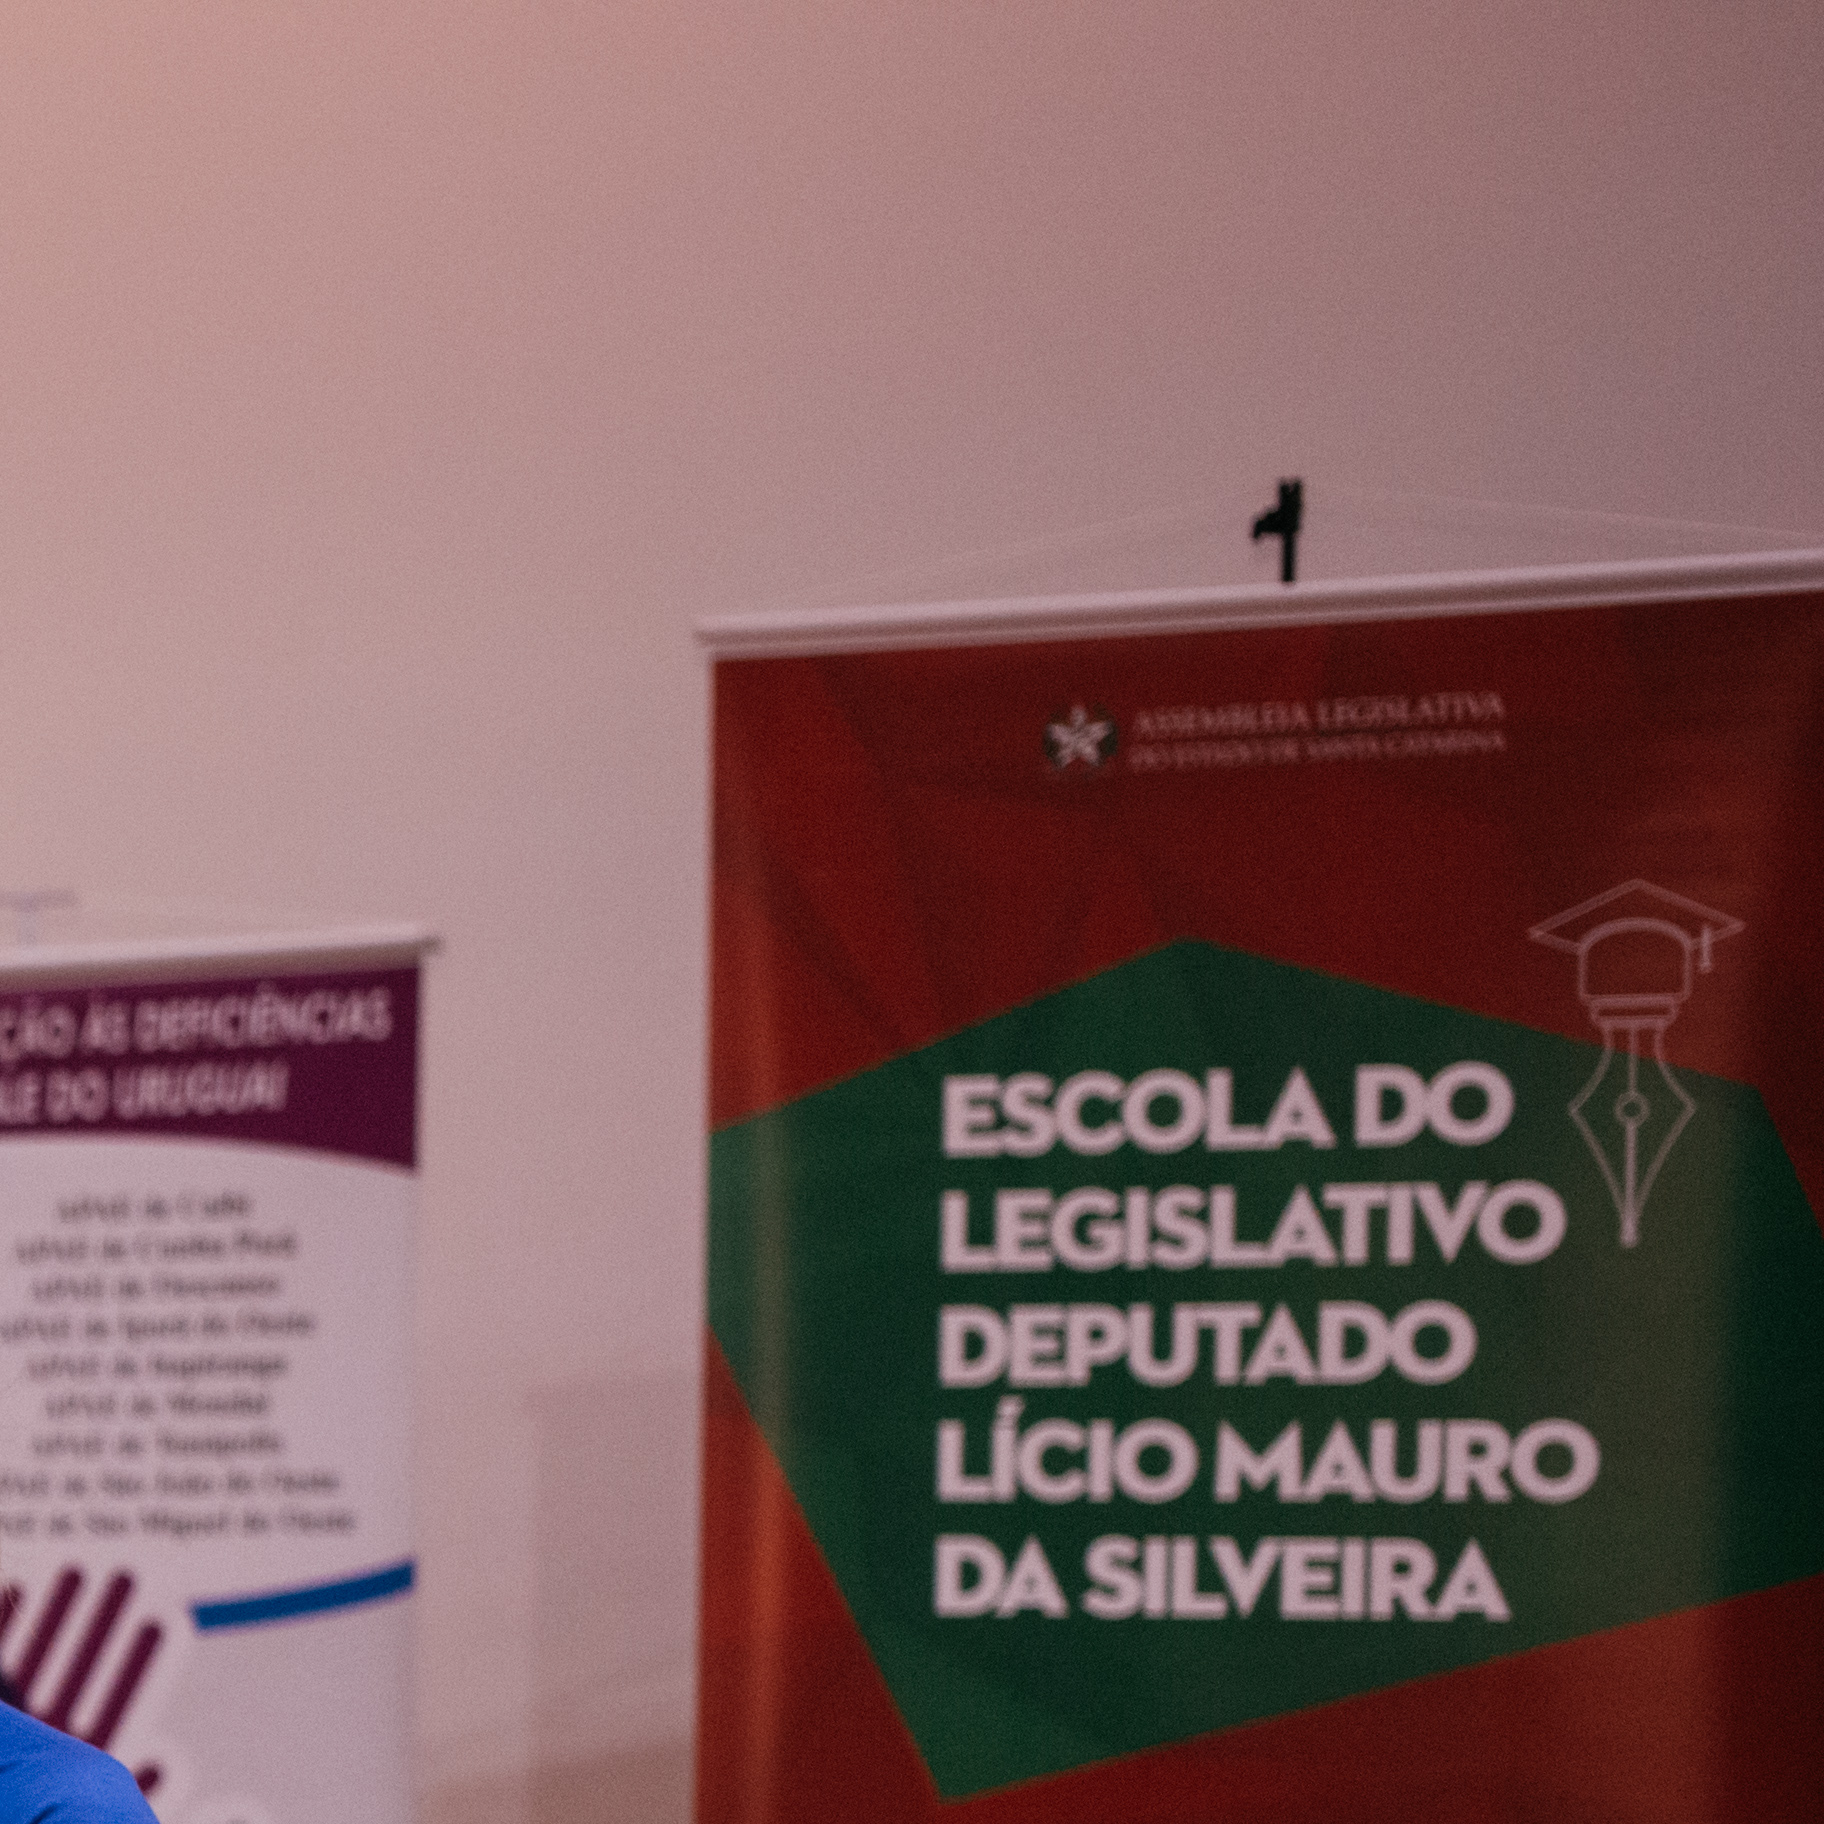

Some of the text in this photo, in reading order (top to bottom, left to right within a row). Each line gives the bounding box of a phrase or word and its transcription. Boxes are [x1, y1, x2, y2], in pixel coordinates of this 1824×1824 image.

[942, 1060, 1515, 1159] ESCOLA DO
[939, 1178, 1569, 1274] LEGISLATIVO
[938, 1300, 1478, 1388] DEPUTADO
[934, 1395, 1601, 1504] LÍCIO MAURO
[933, 1533, 1512, 1623] DA SILVEIRA
